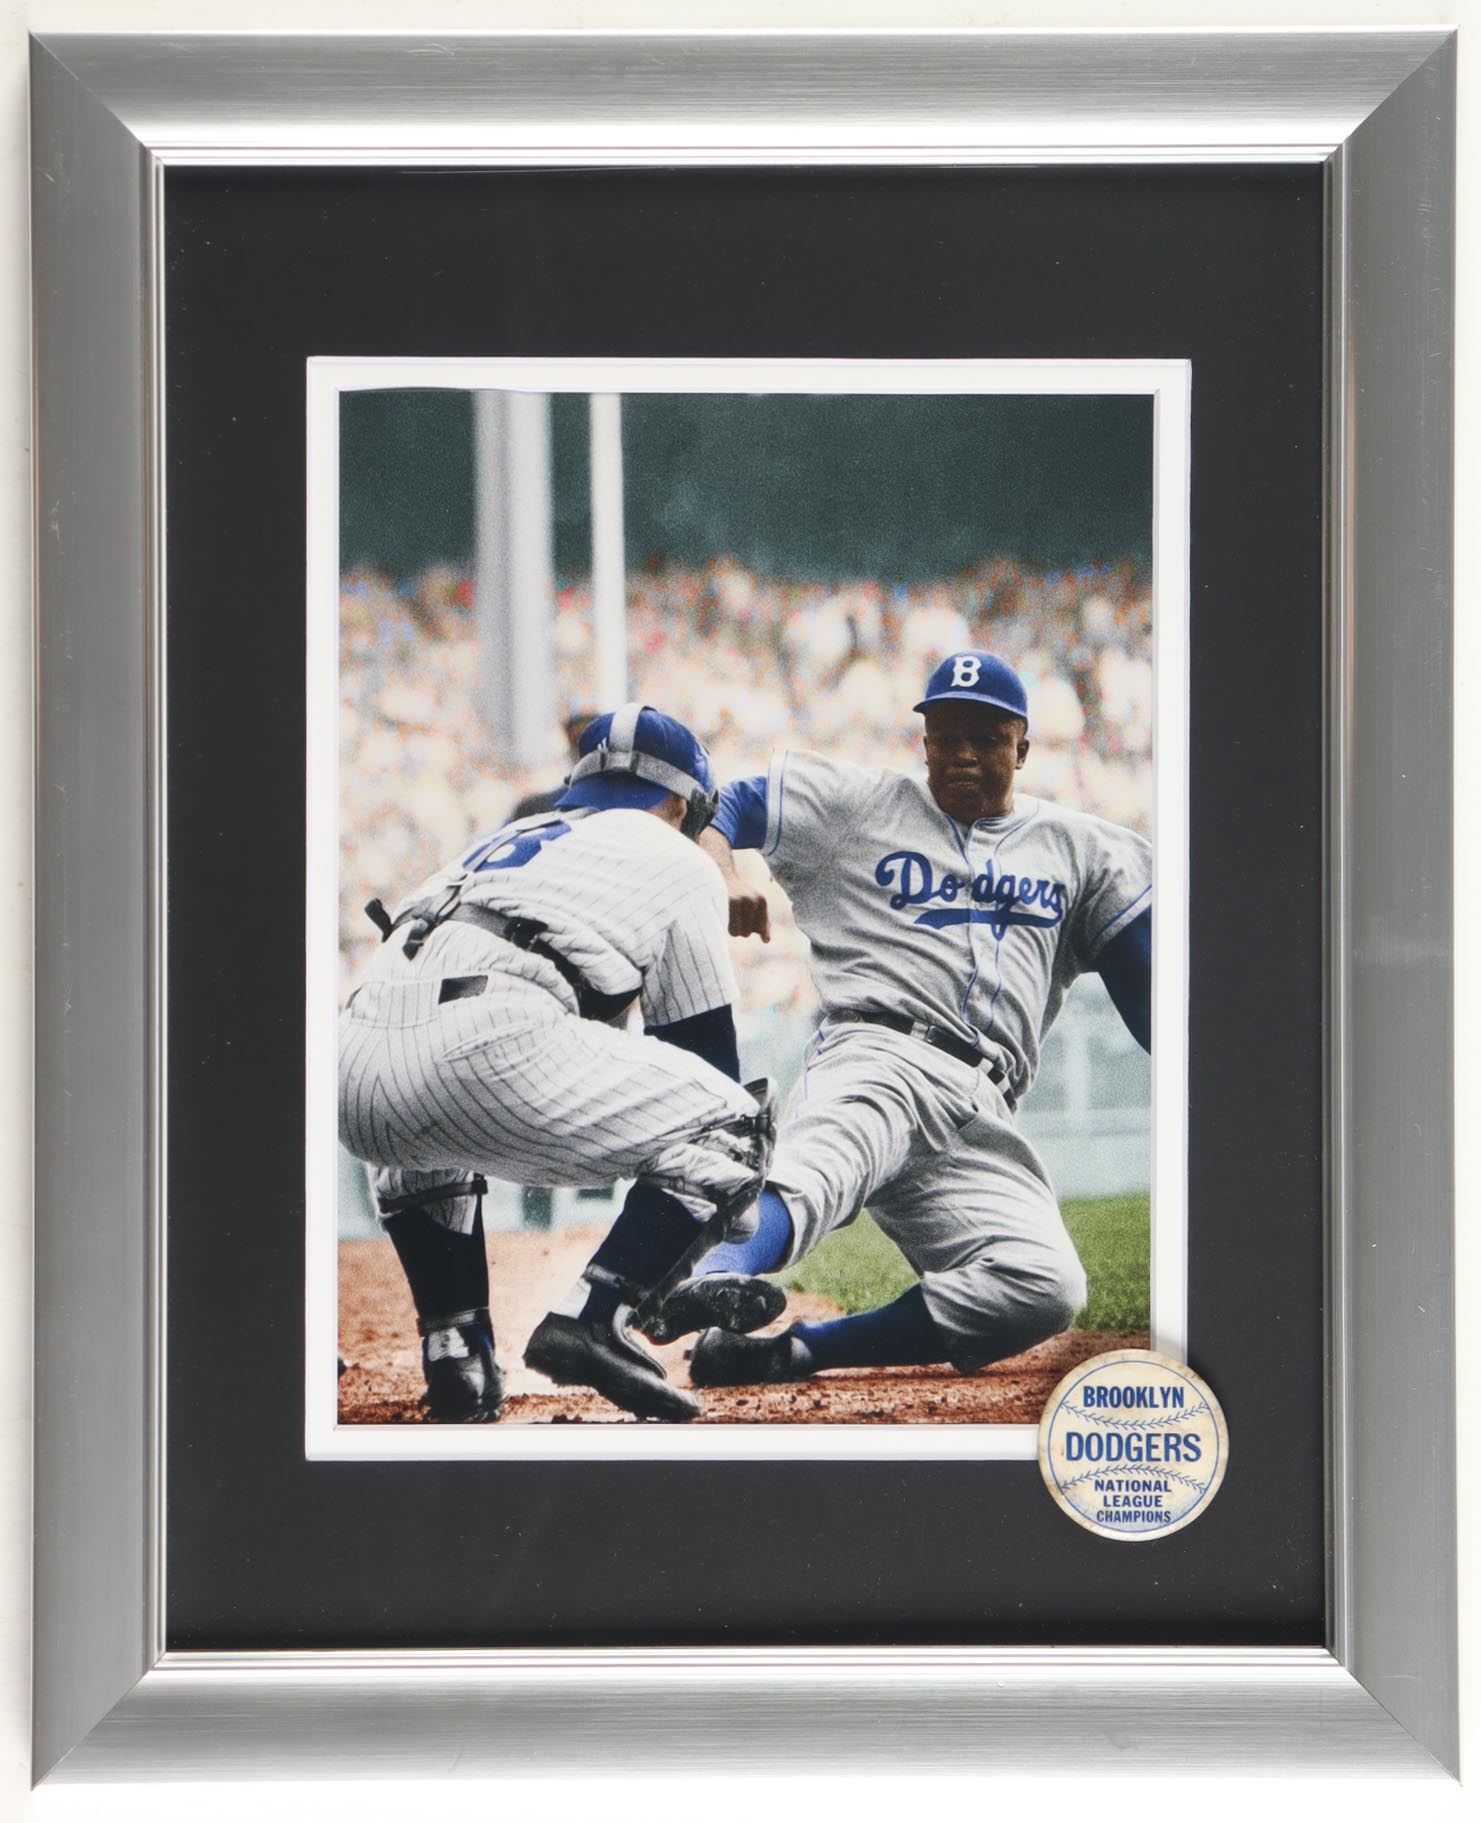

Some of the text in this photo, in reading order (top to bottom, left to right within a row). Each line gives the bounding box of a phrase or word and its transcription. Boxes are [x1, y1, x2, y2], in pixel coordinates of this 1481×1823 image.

[951, 655, 982, 688] B
[875, 850, 1065, 941] Dodgers
[1083, 1385, 1184, 1408] BROOKLYN
[1065, 1431, 1202, 1463] DODGERS
[1094, 1479, 1172, 1492] NATIONAL
[1103, 1495, 1163, 1508] LEAGUE
[1096, 1510, 1171, 1523] CHAMPIONS
